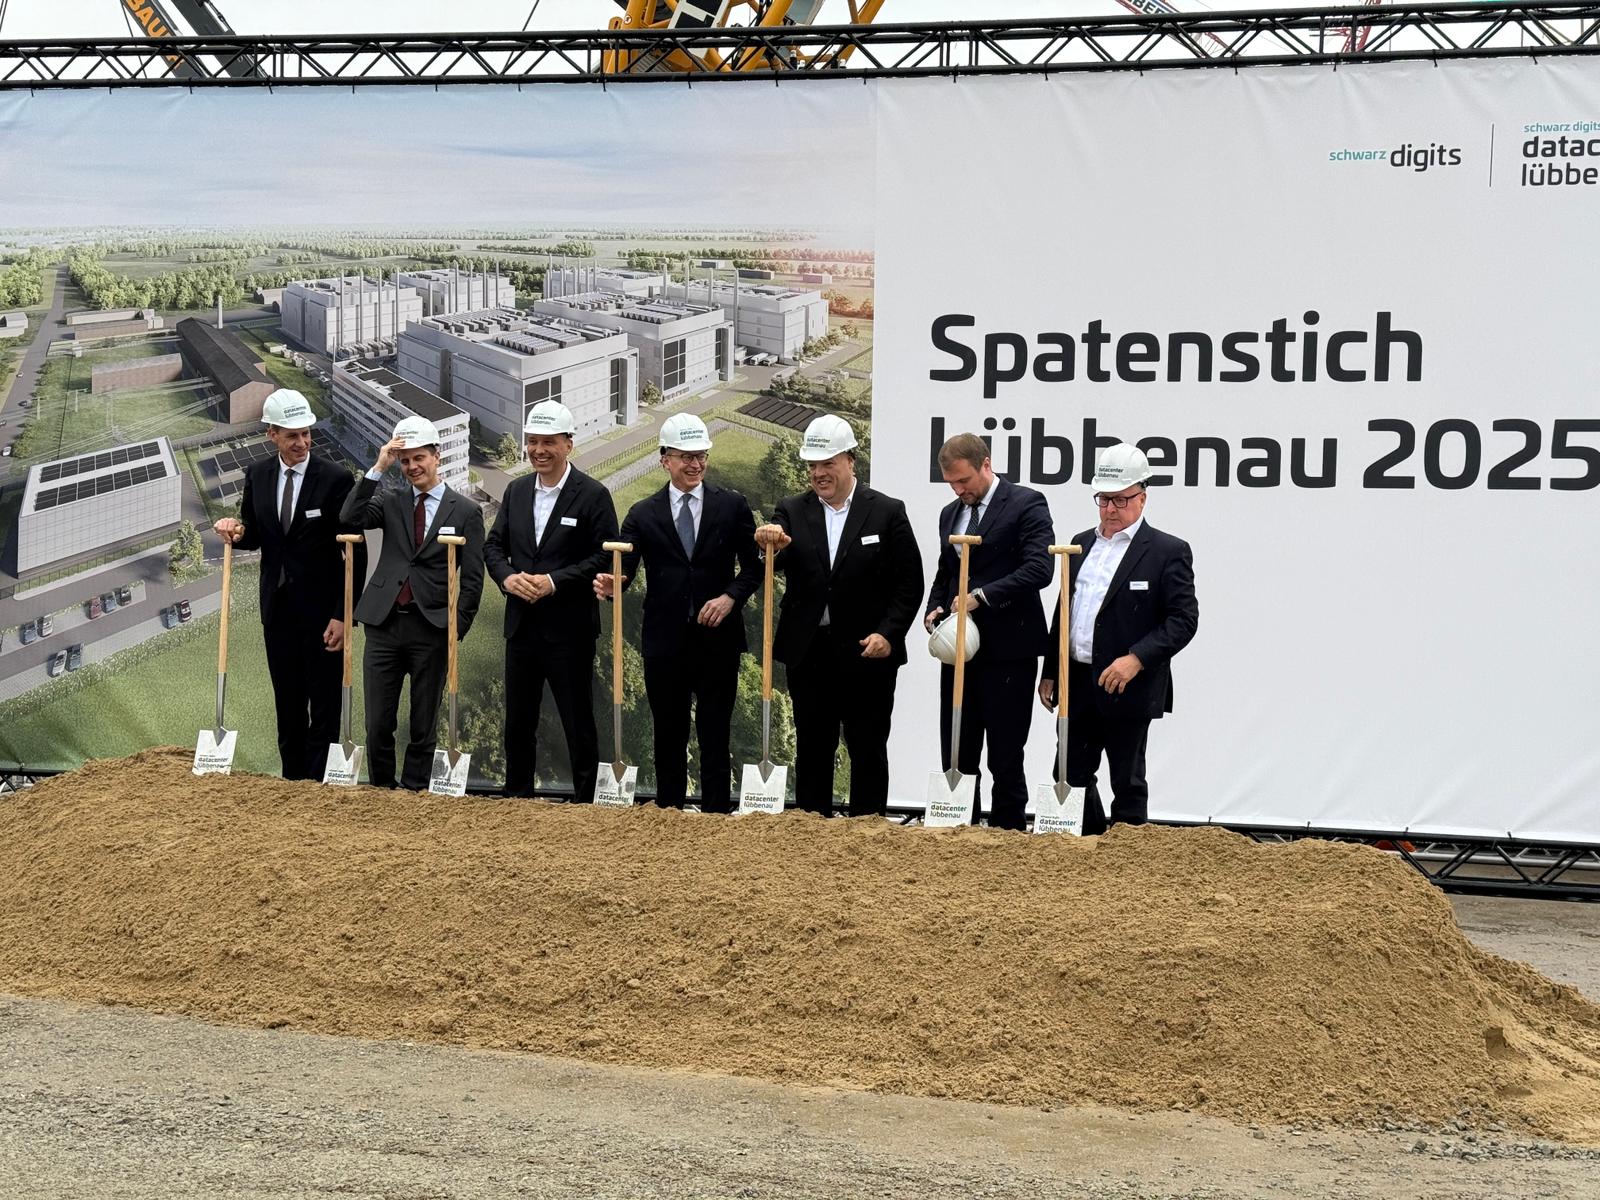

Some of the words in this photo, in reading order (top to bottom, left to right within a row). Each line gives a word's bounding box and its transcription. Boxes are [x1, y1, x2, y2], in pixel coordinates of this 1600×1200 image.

[1523, 122, 1570, 133] schwarz
[1328, 148, 1387, 161] schwarz
[1390, 142, 1462, 172] digits
[1522, 135, 1600, 158] datac
[1521, 162, 1599, 186] lübbe
[929, 310, 1424, 399] Spatenstich
[1362, 418, 1600, 491] 2025
[930, 810, 960, 818] lübbenau
[931, 804, 967, 812] datacenter
[1040, 818, 1076, 826] datacenter
